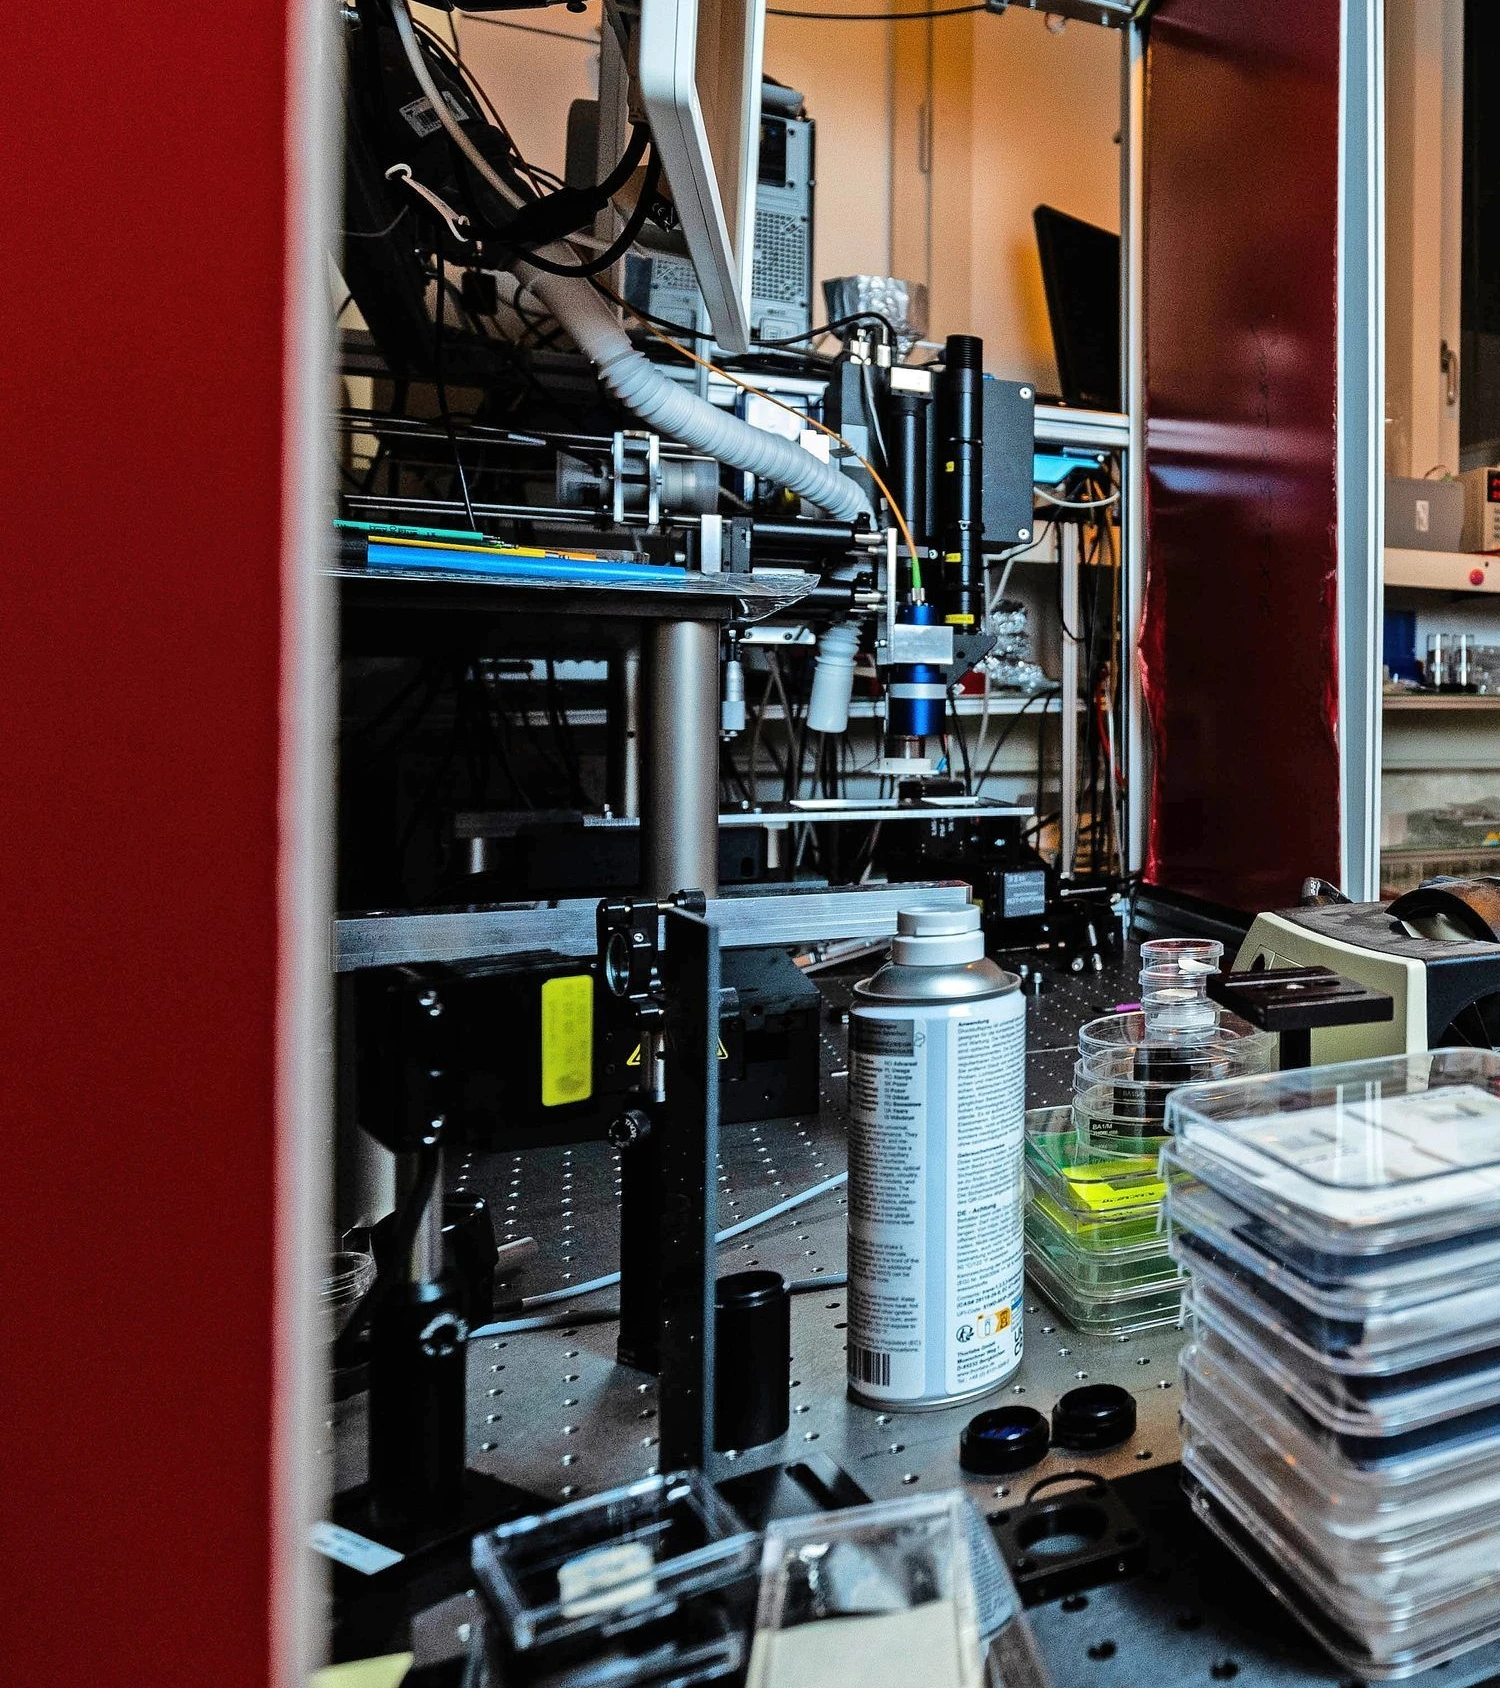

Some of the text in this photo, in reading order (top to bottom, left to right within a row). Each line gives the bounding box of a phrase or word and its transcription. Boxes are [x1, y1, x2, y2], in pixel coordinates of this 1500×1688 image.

[1092, 1124, 1114, 1132] BA1/M
[957, 1209, 968, 1218] DE
[973, 1202, 997, 1214] Achtung
